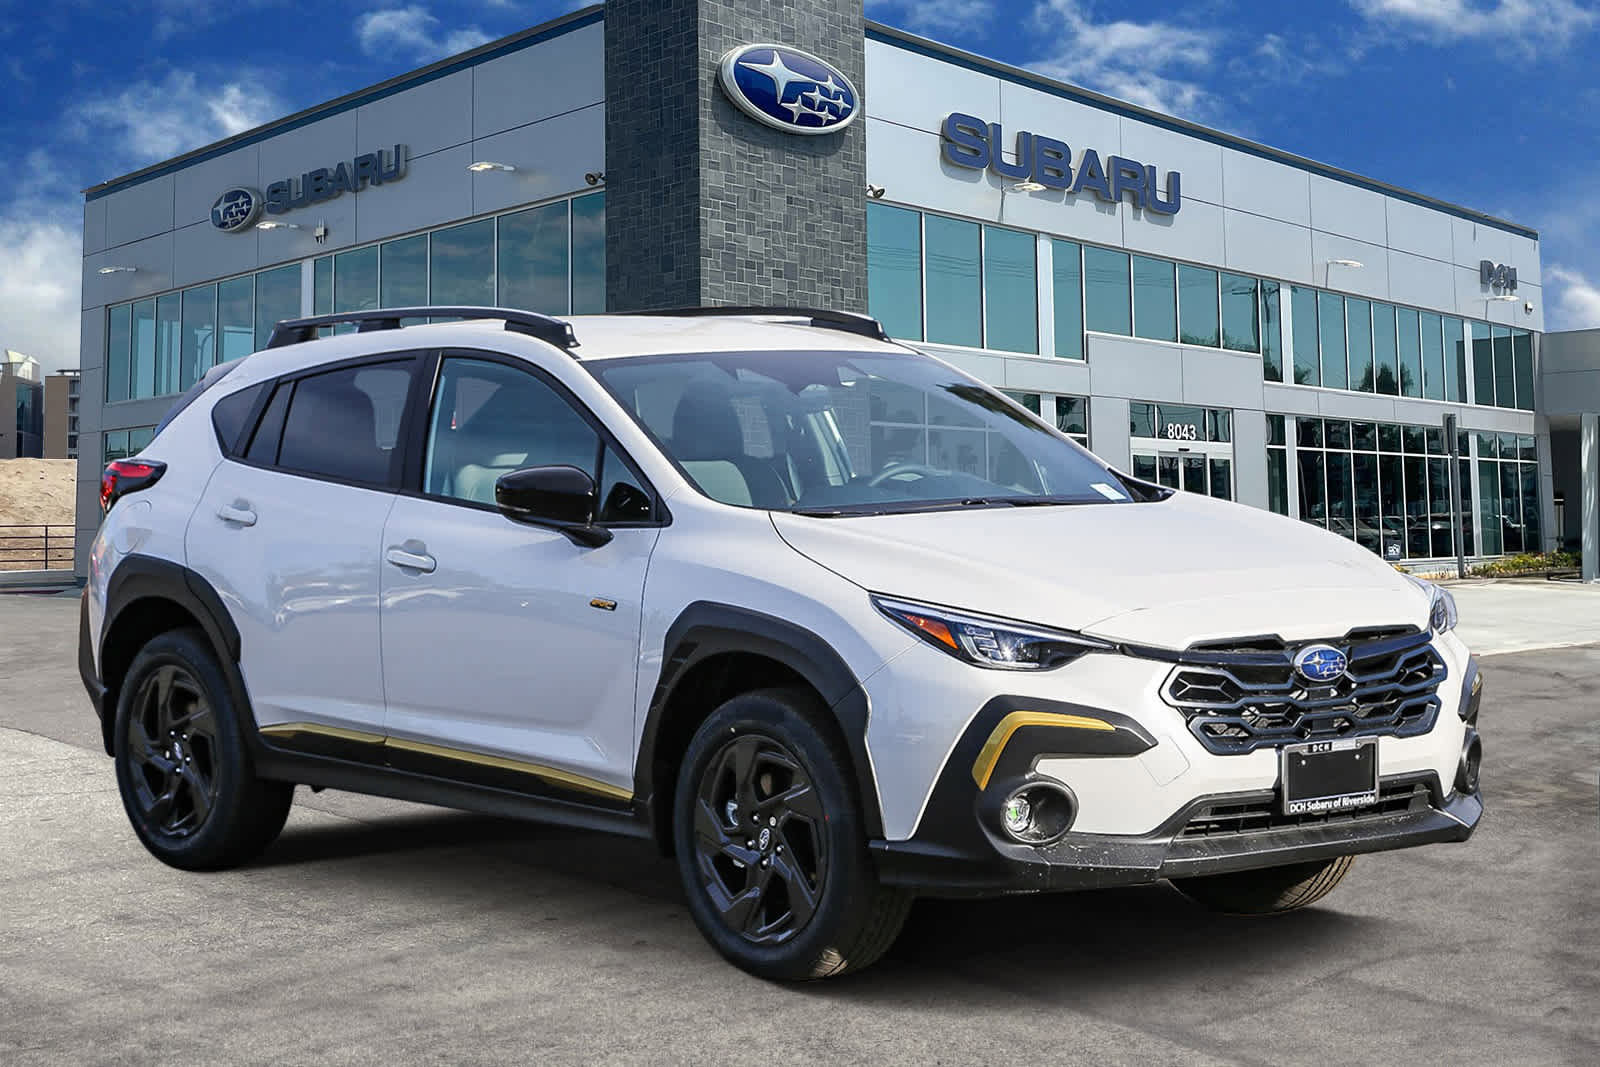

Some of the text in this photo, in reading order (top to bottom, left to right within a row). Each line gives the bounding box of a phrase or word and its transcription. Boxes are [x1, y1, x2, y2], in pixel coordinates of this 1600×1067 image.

[266, 144, 407, 214] SUBARU
[939, 112, 1181, 215] SUBARU
[1167, 422, 1197, 440] 8043
[1290, 793, 1375, 813] DCH Subaru of Riverside
